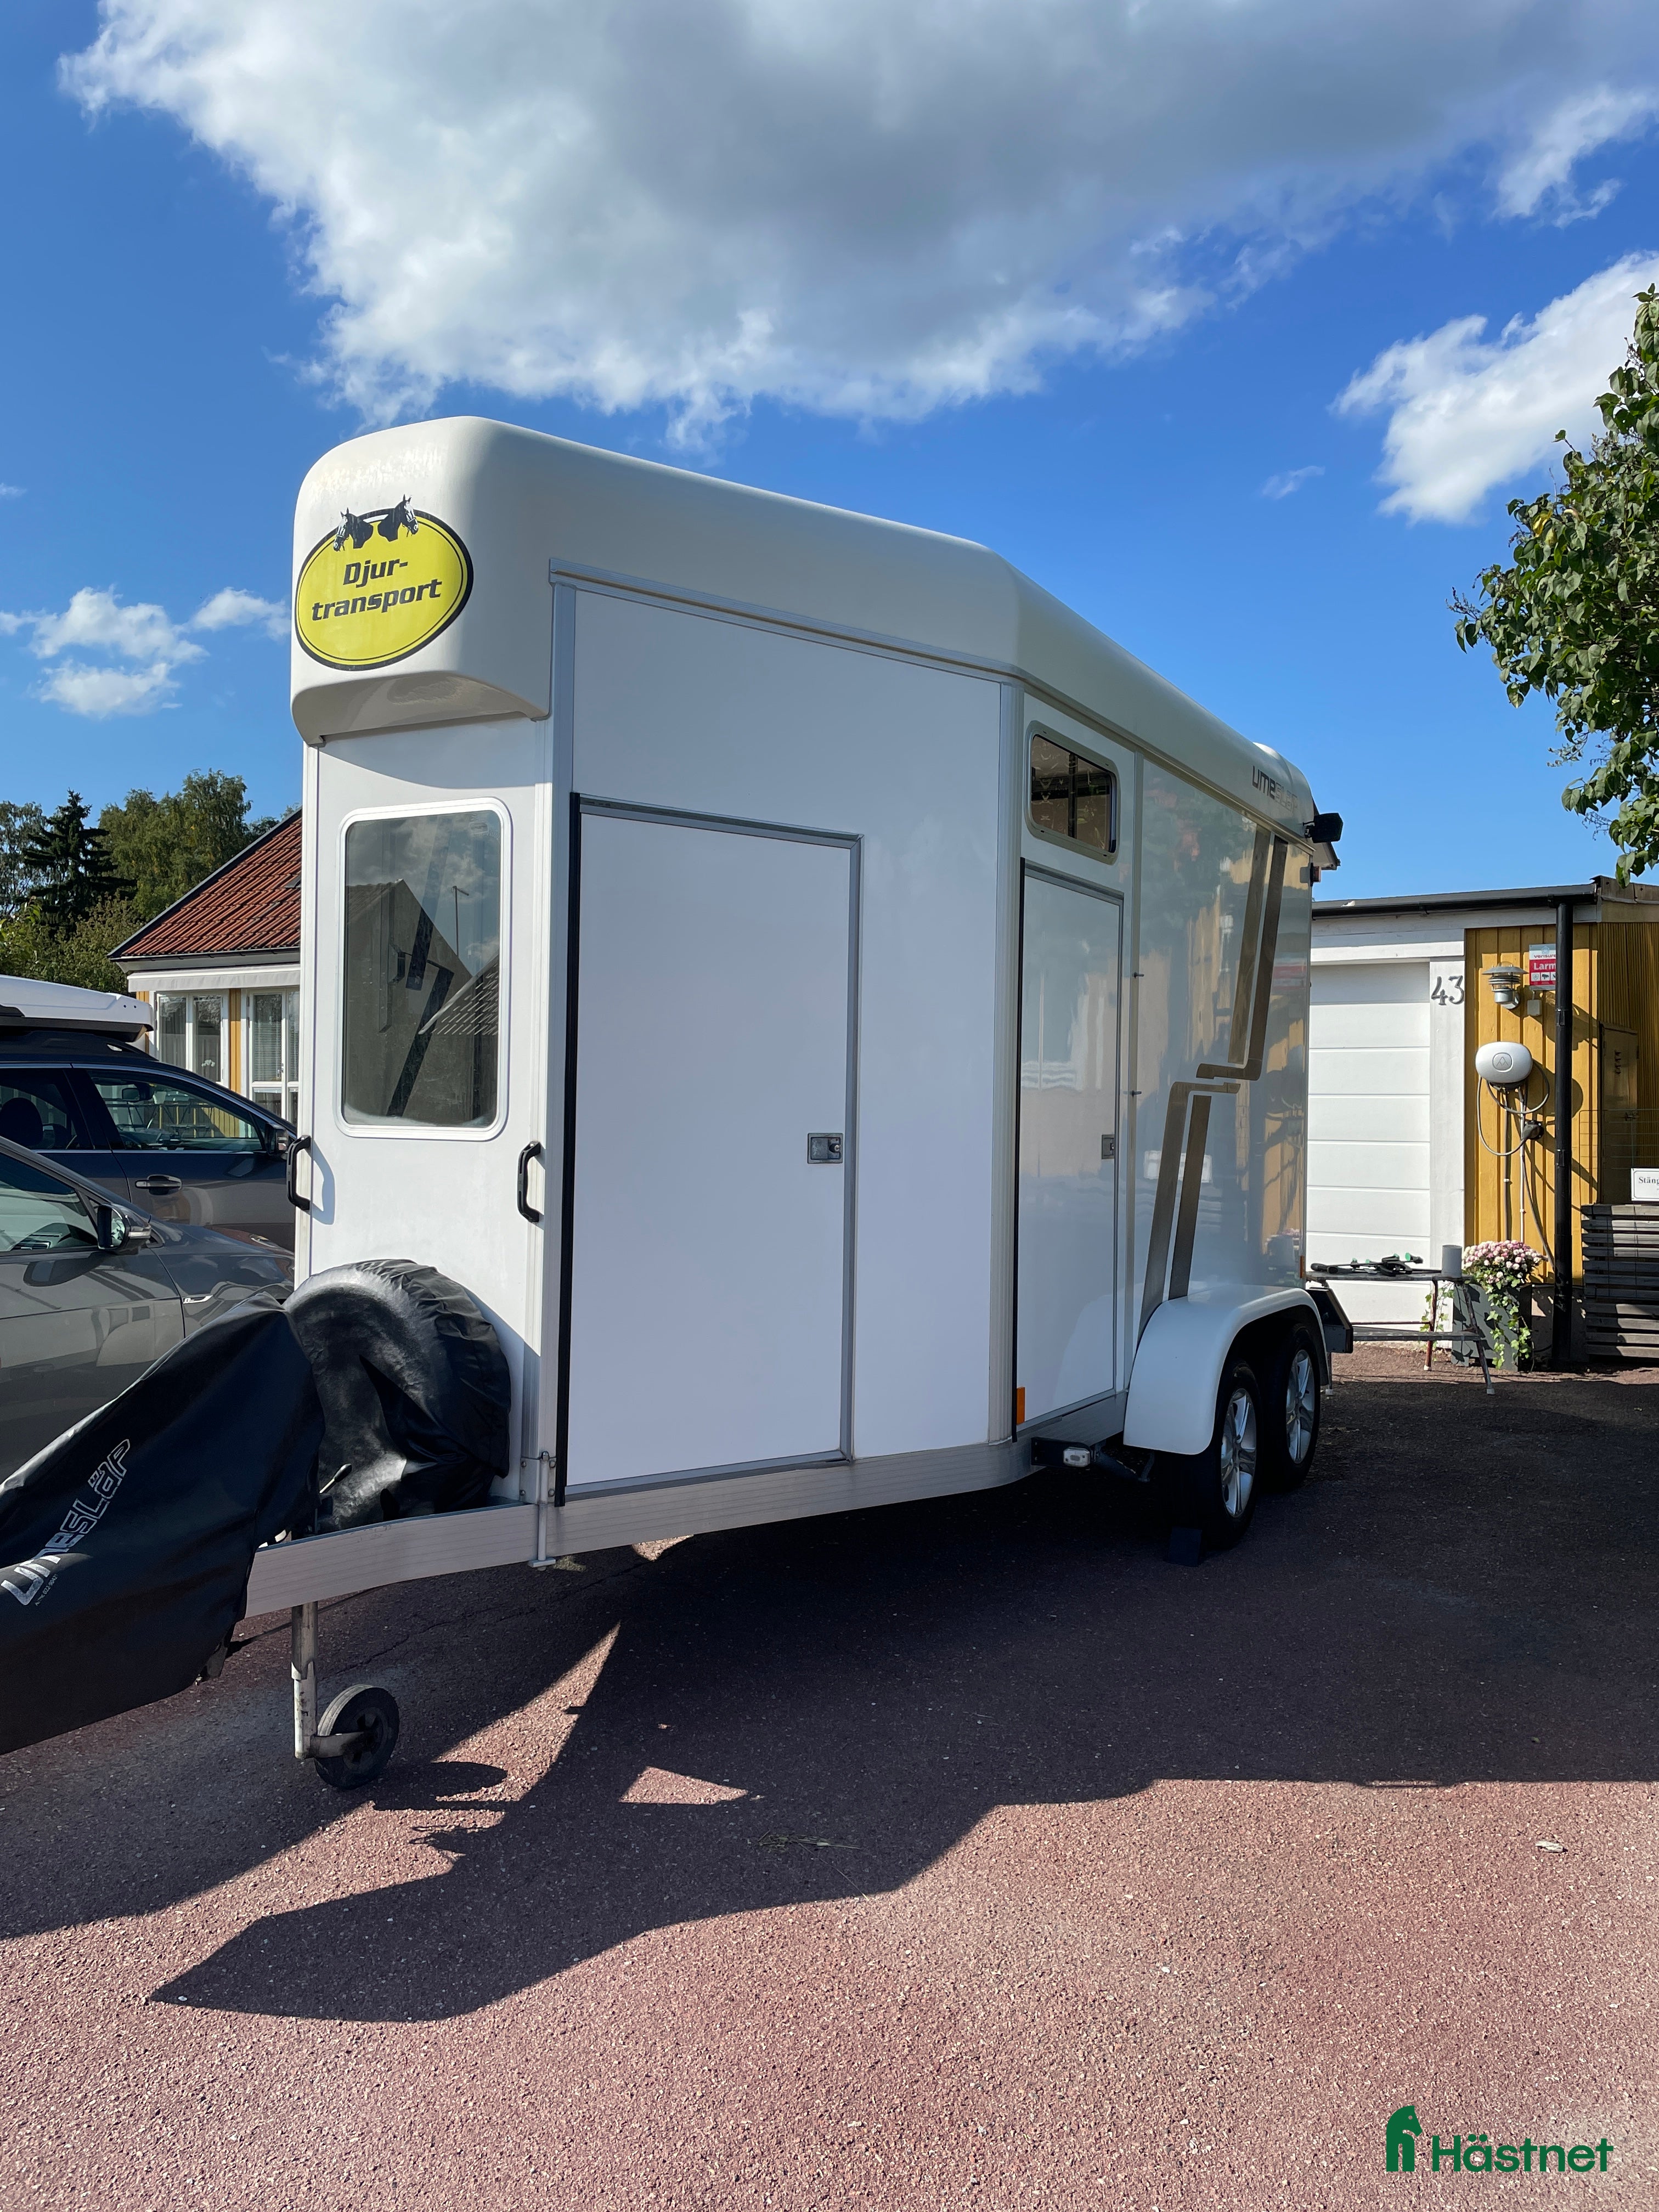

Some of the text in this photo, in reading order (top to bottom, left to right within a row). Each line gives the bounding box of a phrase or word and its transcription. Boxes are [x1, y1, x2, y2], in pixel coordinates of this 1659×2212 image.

[343, 558, 408, 588] Djur-
[311, 579, 442, 621] transport
[1533, 962, 1556, 970] Larm
[1431, 975, 1464, 1006] 43
